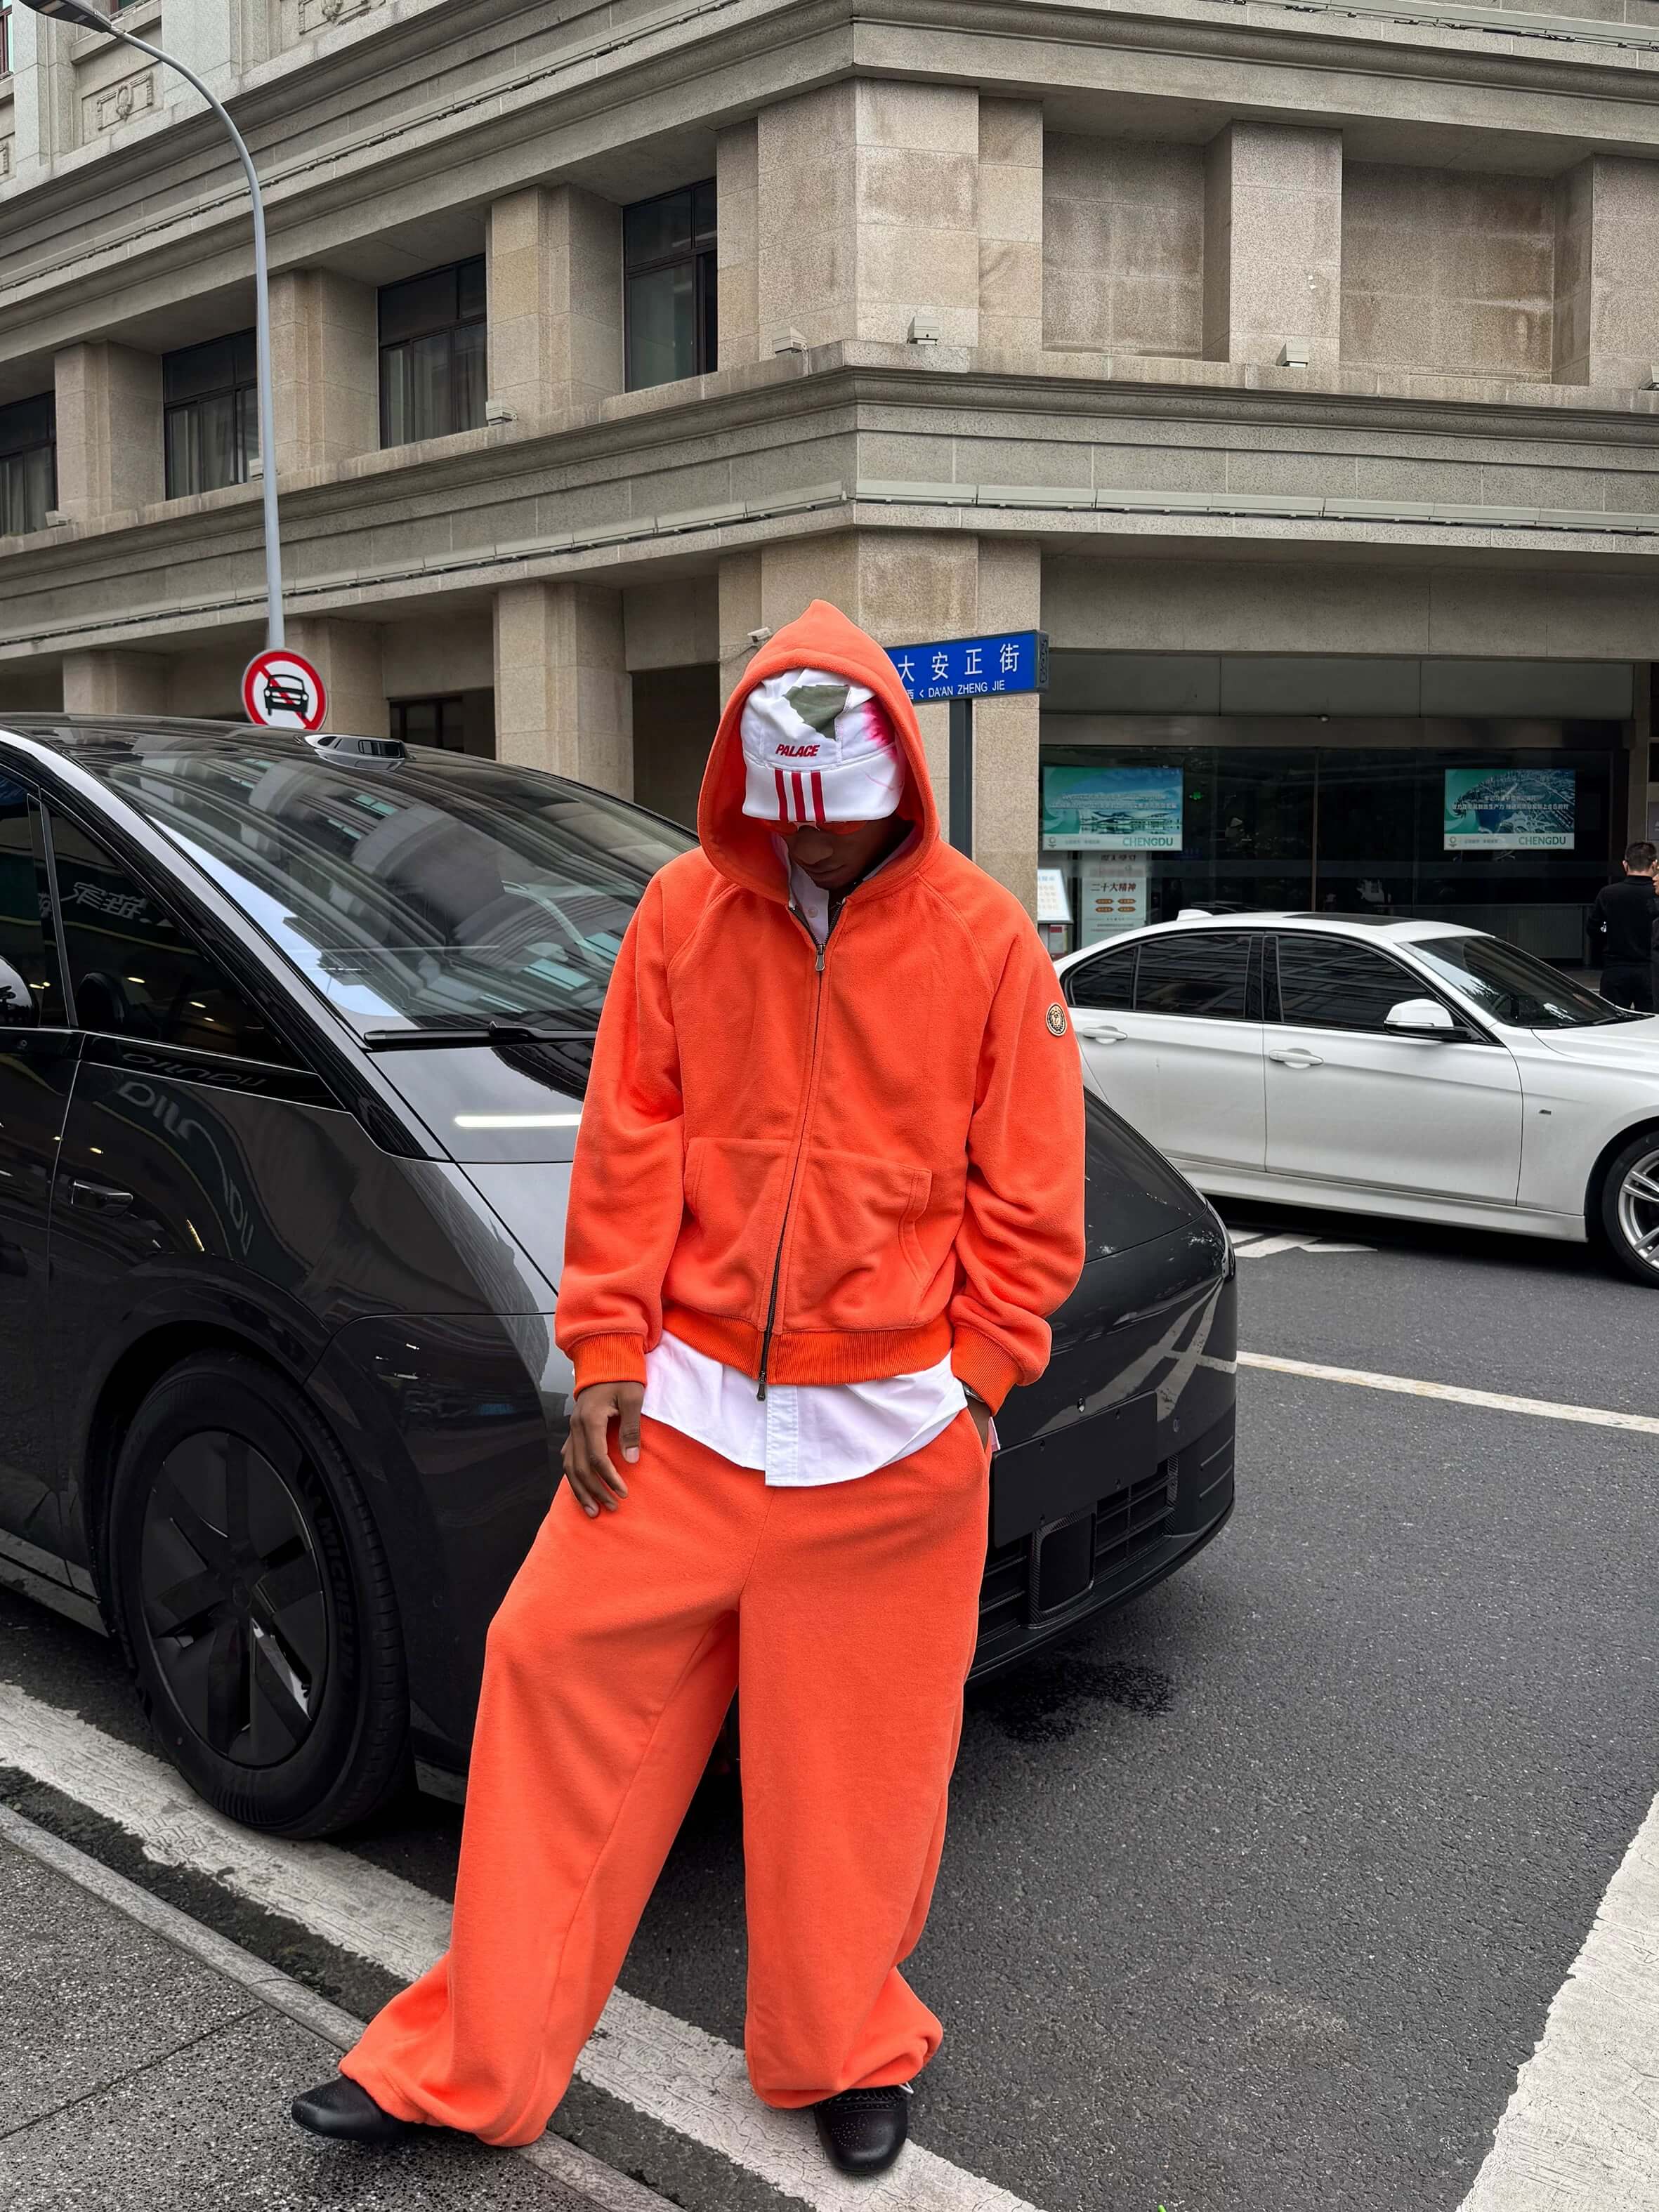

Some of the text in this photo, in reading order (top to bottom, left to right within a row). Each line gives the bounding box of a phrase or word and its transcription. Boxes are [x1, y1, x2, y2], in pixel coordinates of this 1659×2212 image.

[898, 643, 1019, 682] 大安正街
[929, 680, 1005, 697] DA'AN ZHENG JIE
[775, 744, 820, 757] PALACE
[1122, 837, 1174, 846] CHENGDU
[1519, 836, 1566, 845] CHENGDU
[1090, 882, 1136, 892] 二十大精神
